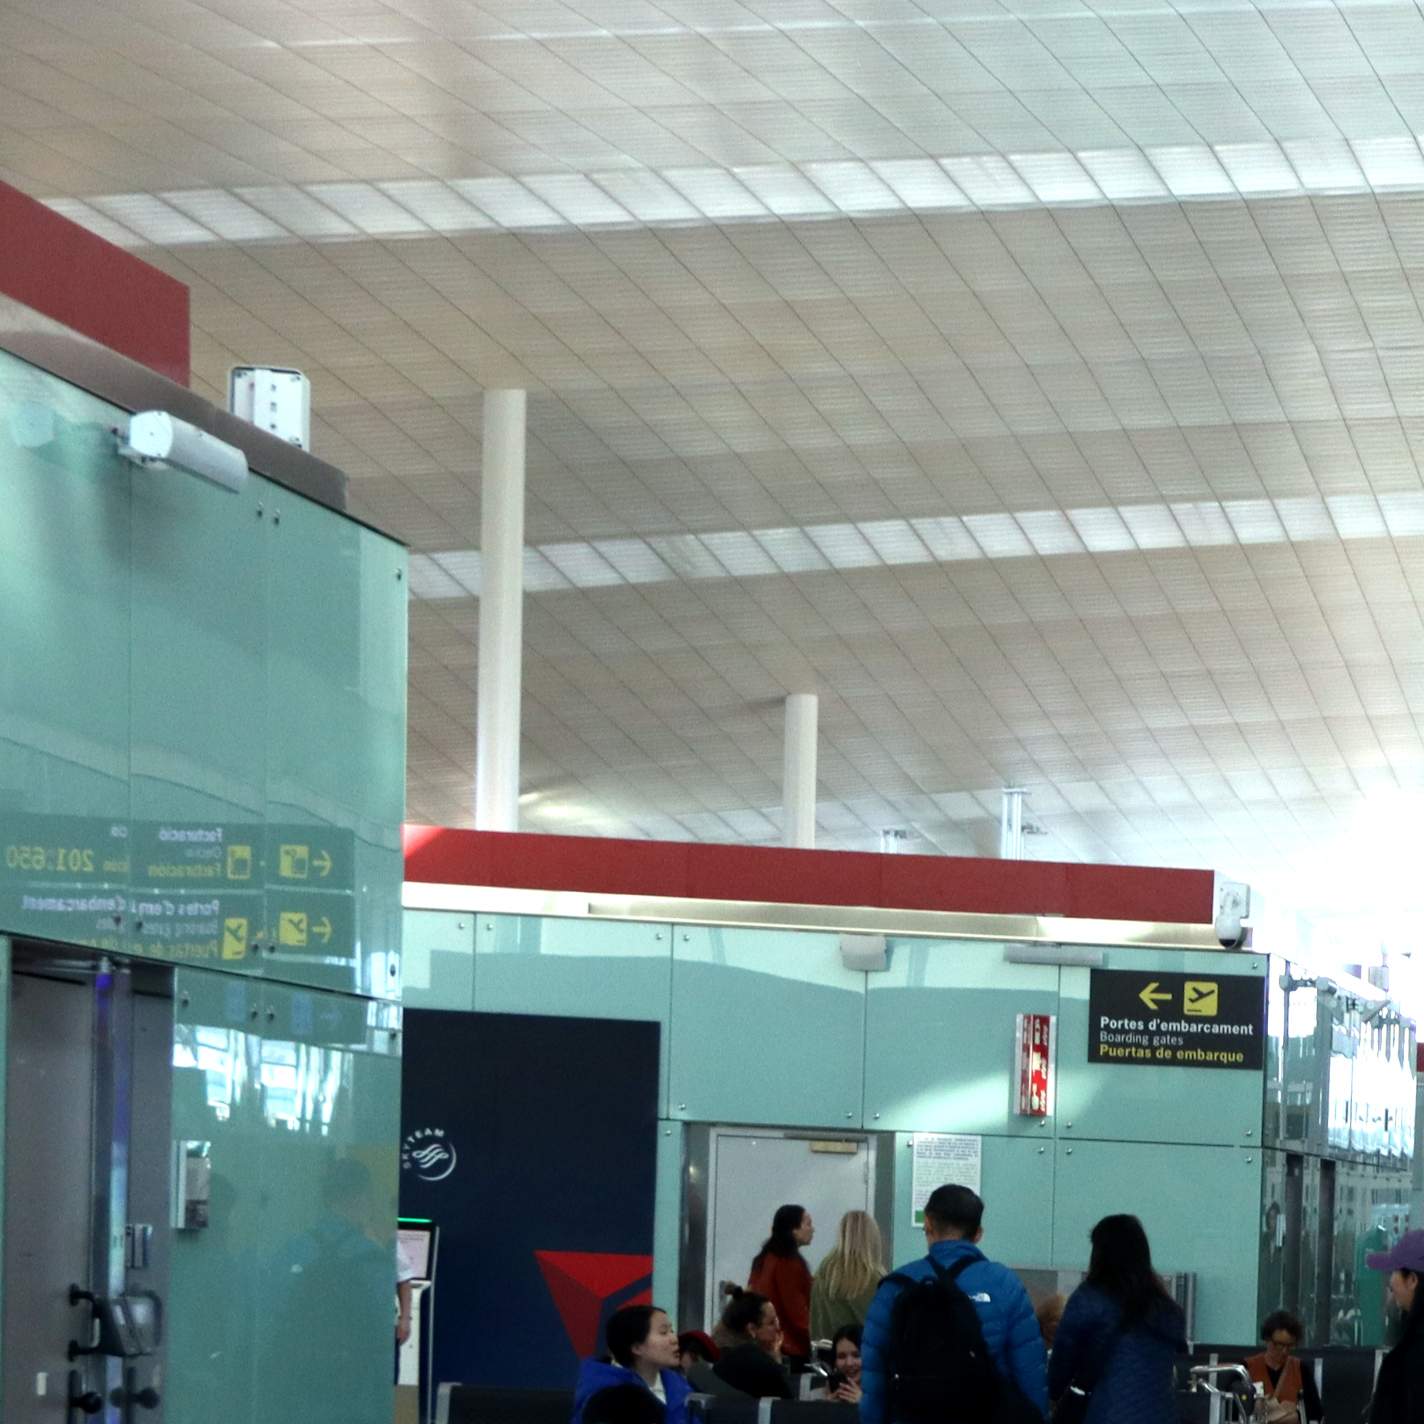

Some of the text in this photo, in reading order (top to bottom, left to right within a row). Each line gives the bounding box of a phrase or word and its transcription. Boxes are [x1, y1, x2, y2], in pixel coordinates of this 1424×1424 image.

[1100, 1016, 1253, 1035] Portes d'embarcament
[1100, 1031, 1184, 1047] Boarding gates
[1100, 1044, 1244, 1063] Puertas de embarque
[402, 1127, 445, 1169] SKYTEAM
